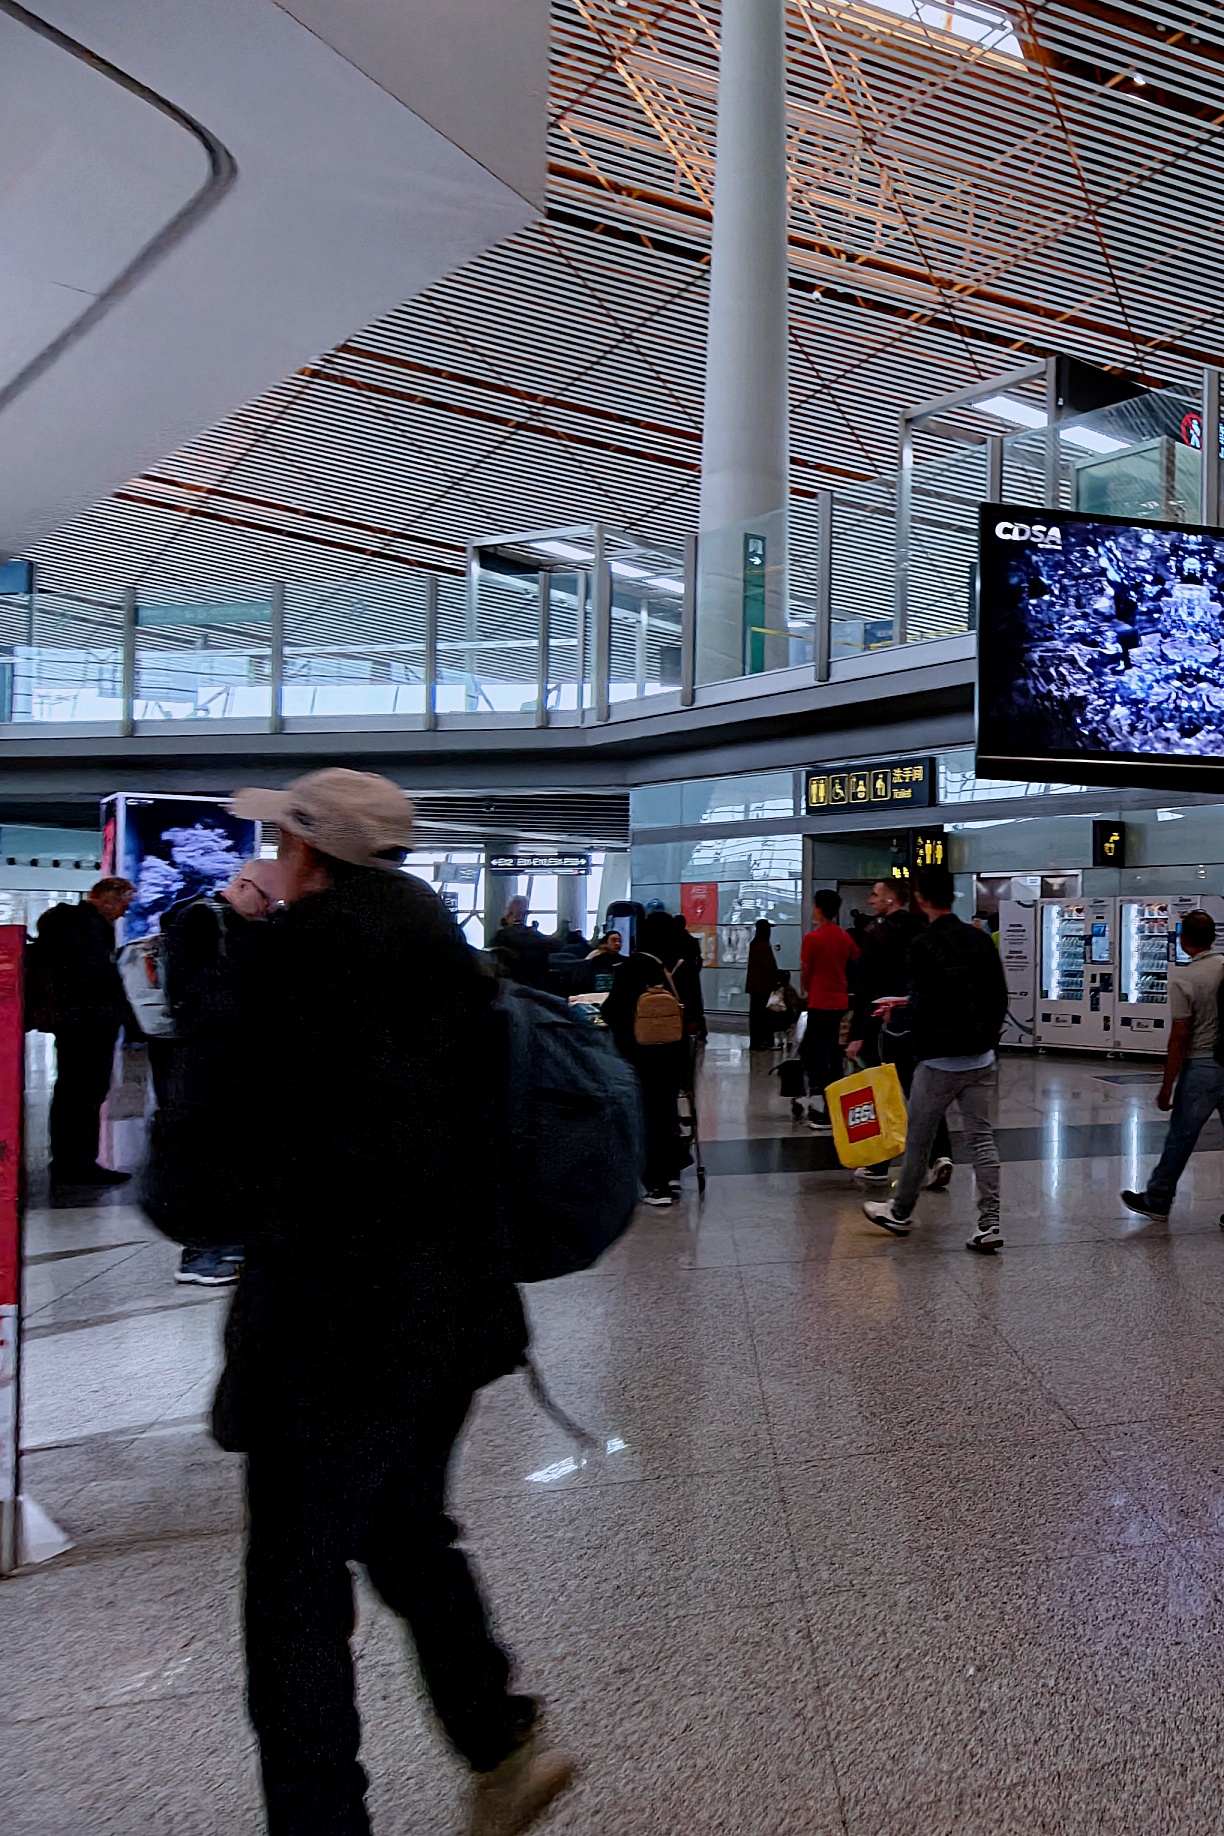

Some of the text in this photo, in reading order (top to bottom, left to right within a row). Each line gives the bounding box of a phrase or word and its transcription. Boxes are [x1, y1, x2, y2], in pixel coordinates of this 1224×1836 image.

[994, 521, 1063, 545] CDSA
[892, 766, 924, 783] 洗手间
